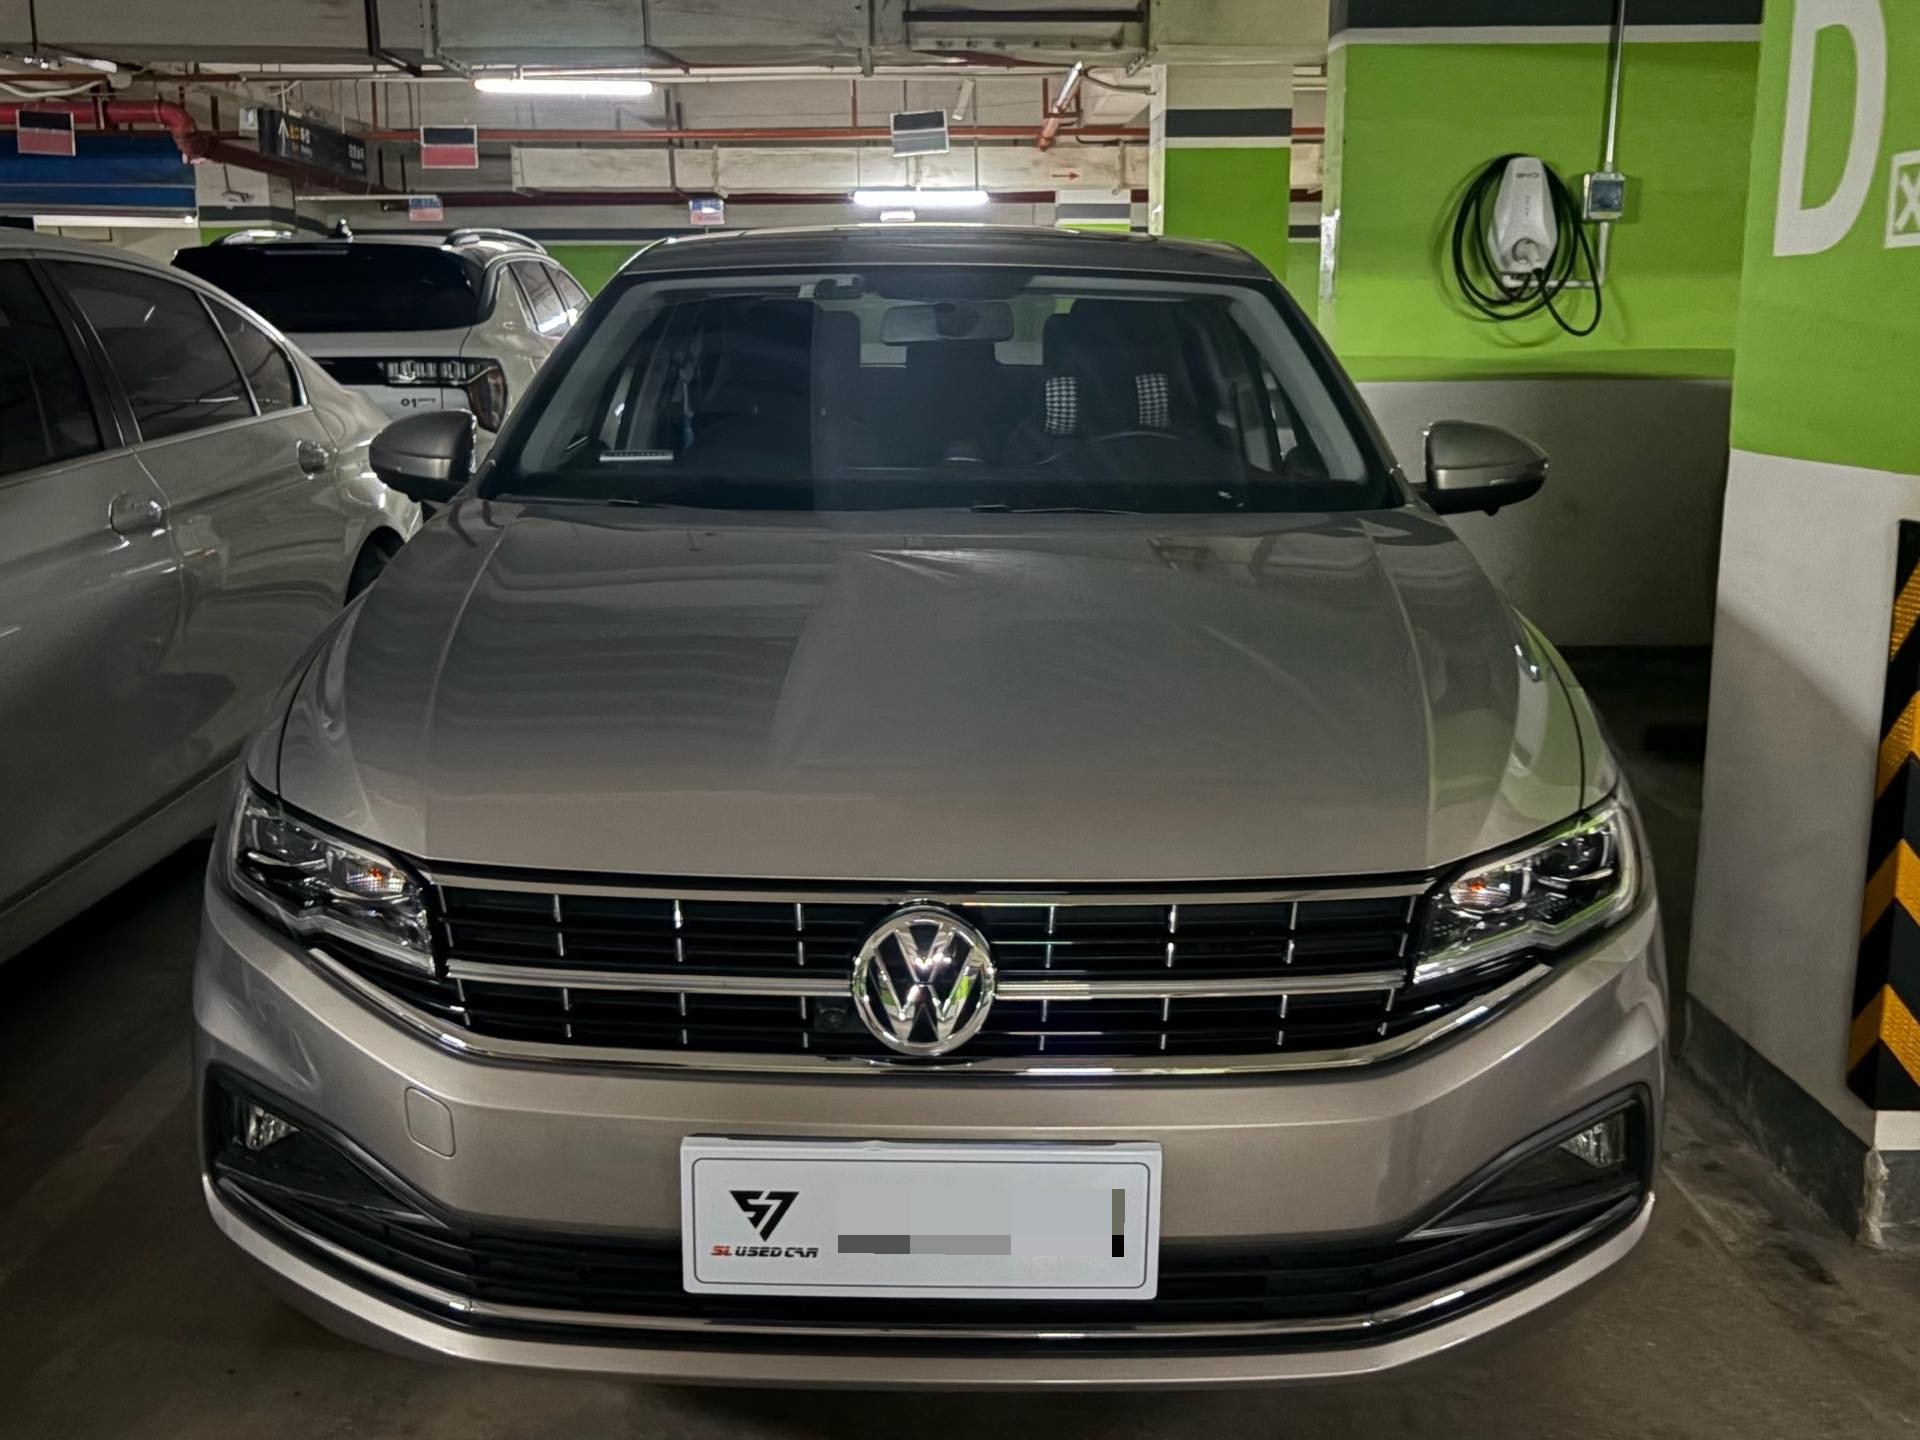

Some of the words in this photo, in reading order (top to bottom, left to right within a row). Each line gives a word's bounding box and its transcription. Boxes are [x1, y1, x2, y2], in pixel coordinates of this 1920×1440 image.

[1773, 0, 1887, 256] D
[710, 1245, 732, 1256] SL
[735, 1246, 782, 1257] USED
[784, 1247, 819, 1258] CAR
